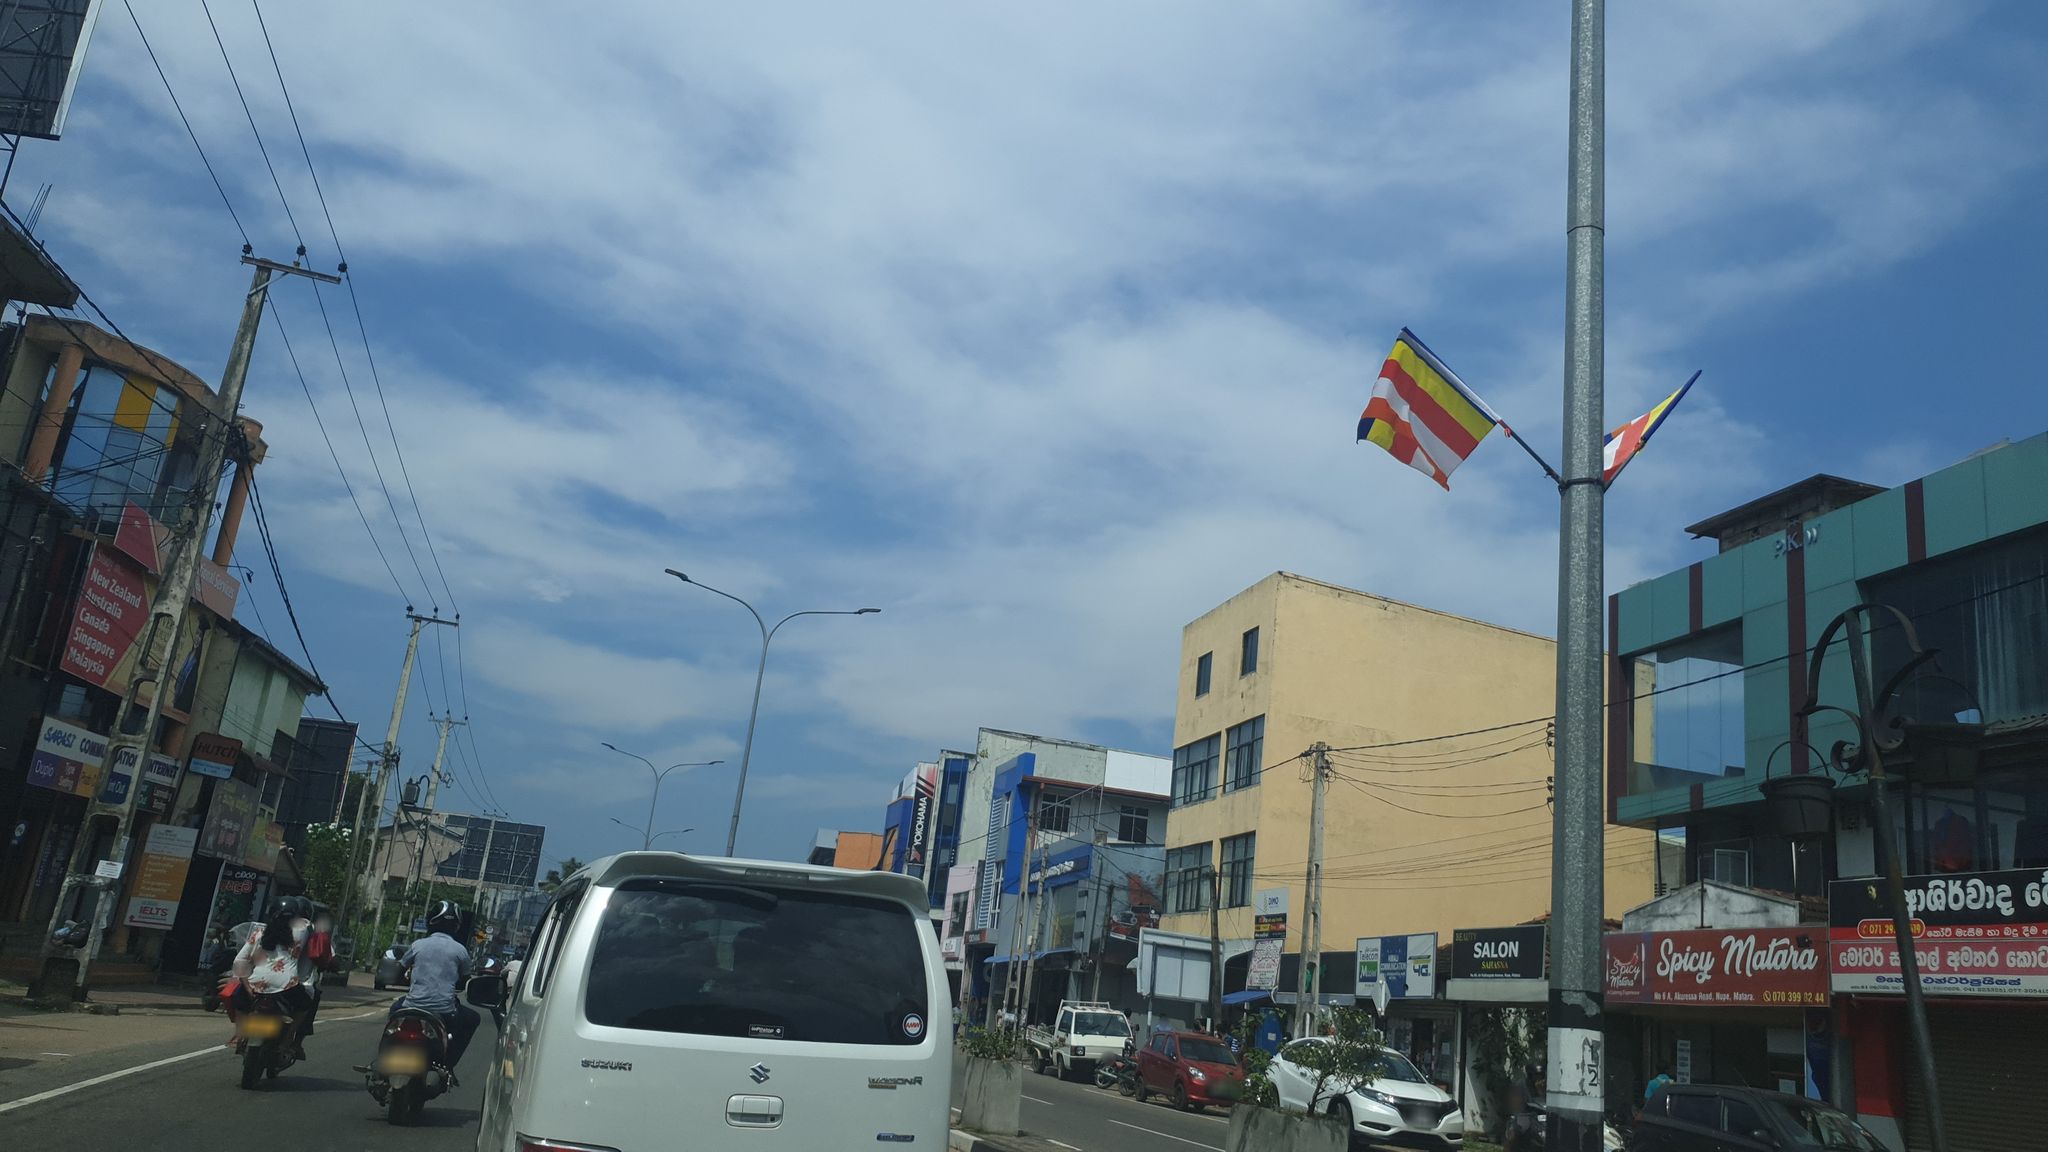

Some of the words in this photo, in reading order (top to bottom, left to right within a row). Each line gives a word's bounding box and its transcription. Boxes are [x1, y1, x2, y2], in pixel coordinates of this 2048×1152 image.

[90, 567, 110, 589] New
[109, 579, 142, 609] Zealand
[86, 587, 123, 619] Australia
[79, 607, 111, 634] Canada
[72, 627, 115, 659] Singapore
[67, 646, 105, 676] Malaysia
[914, 796, 928, 846] YOKOHAMA
[139, 904, 169, 918] IELTS
[1869, 924, 1881, 935] 071
[1473, 941, 1519, 958] SALON
[1656, 938, 1715, 984] Spicy
[1720, 934, 1819, 977] Matara
[1610, 959, 1640, 981] Spicy
[1653, 991, 1661, 1000] No
[1674, 991, 1698, 1001] Akuressa
[1699, 991, 1714, 1001] Road,
[1772, 991, 1786, 1001] 070
[1788, 991, 1802, 1002] 399
[1814, 992, 1825, 1003] 44
[581, 1059, 632, 1071] SUZUKI
